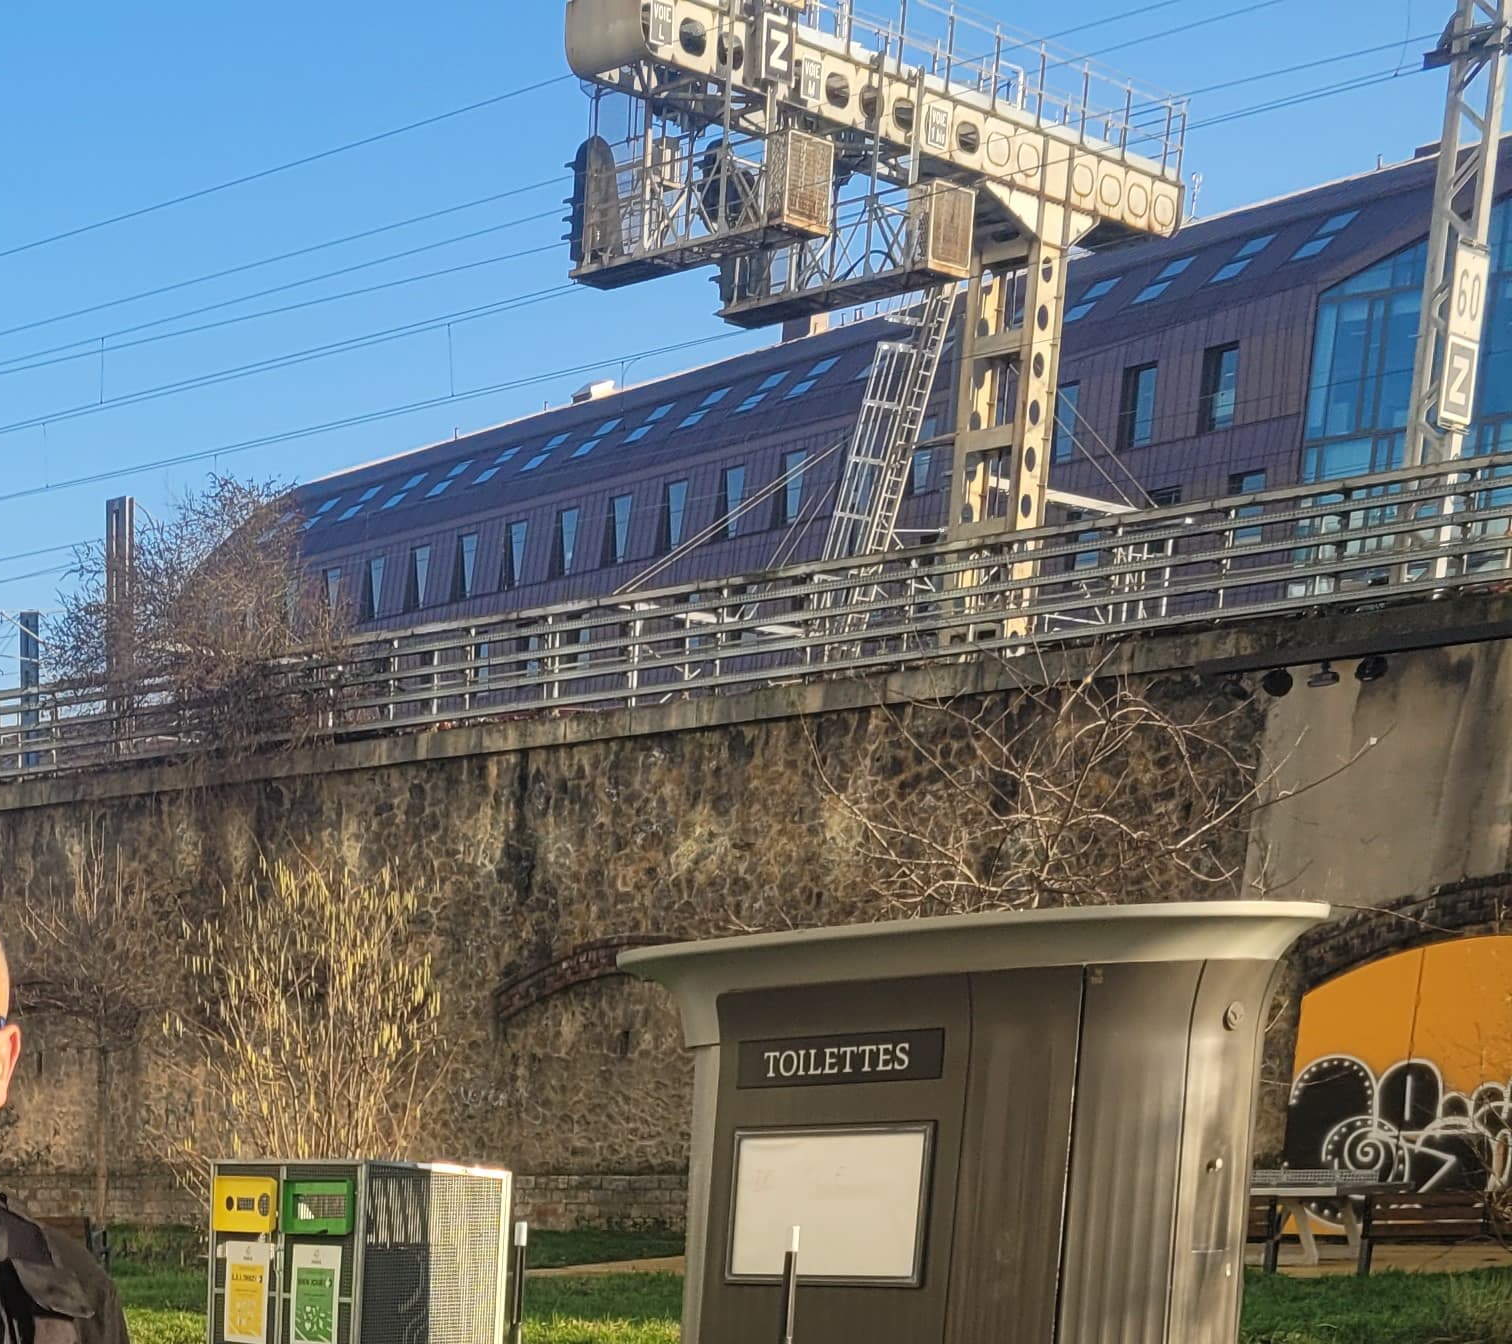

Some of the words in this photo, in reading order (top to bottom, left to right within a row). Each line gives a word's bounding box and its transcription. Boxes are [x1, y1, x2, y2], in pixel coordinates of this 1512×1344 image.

[654, 2, 672, 23] VOIE
[658, 23, 665, 41] L
[769, 28, 789, 72] Z
[804, 59, 821, 79] VOIE
[932, 109, 947, 127] VOIE
[1457, 268, 1481, 321] 60
[1449, 355, 1470, 405] Z
[764, 1042, 910, 1078] TOILETTES
